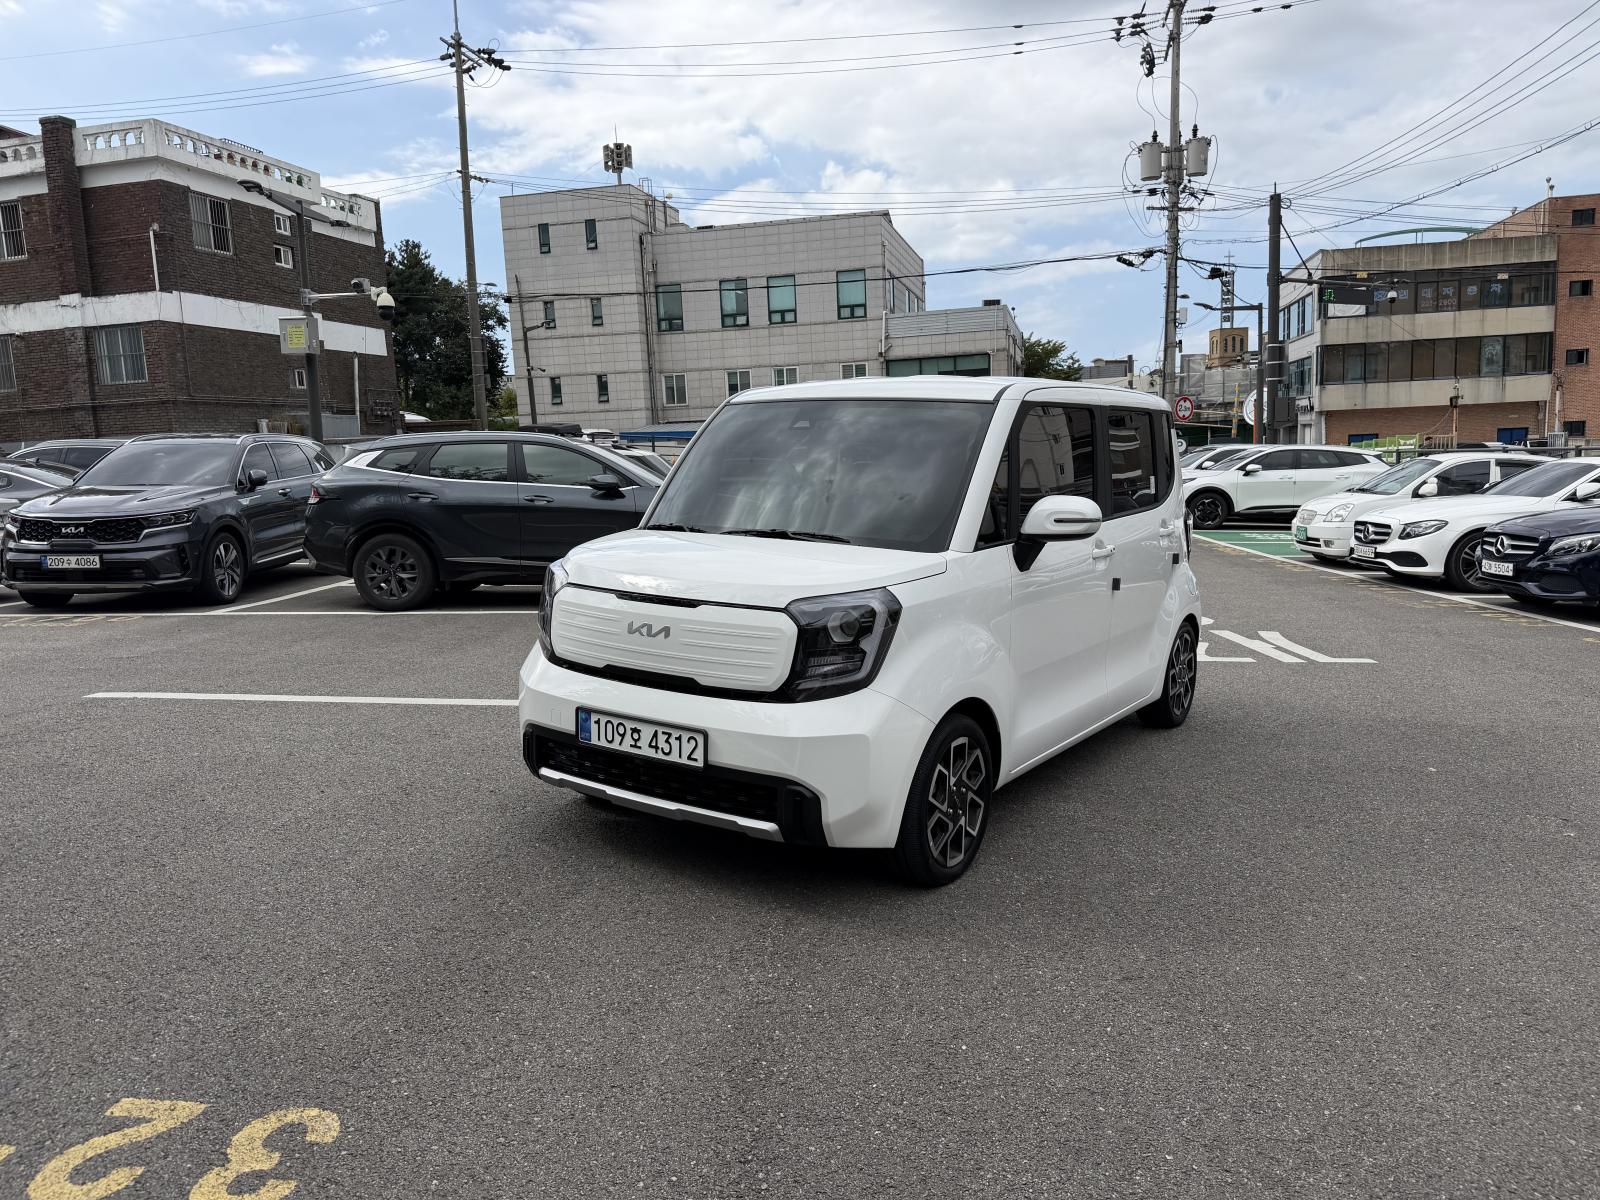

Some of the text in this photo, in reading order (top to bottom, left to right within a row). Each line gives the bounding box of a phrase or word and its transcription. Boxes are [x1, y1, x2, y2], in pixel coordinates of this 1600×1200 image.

[74, 557, 98, 567] 4086
[627, 620, 671, 640] KIA
[593, 717, 699, 763] 109호 4312
